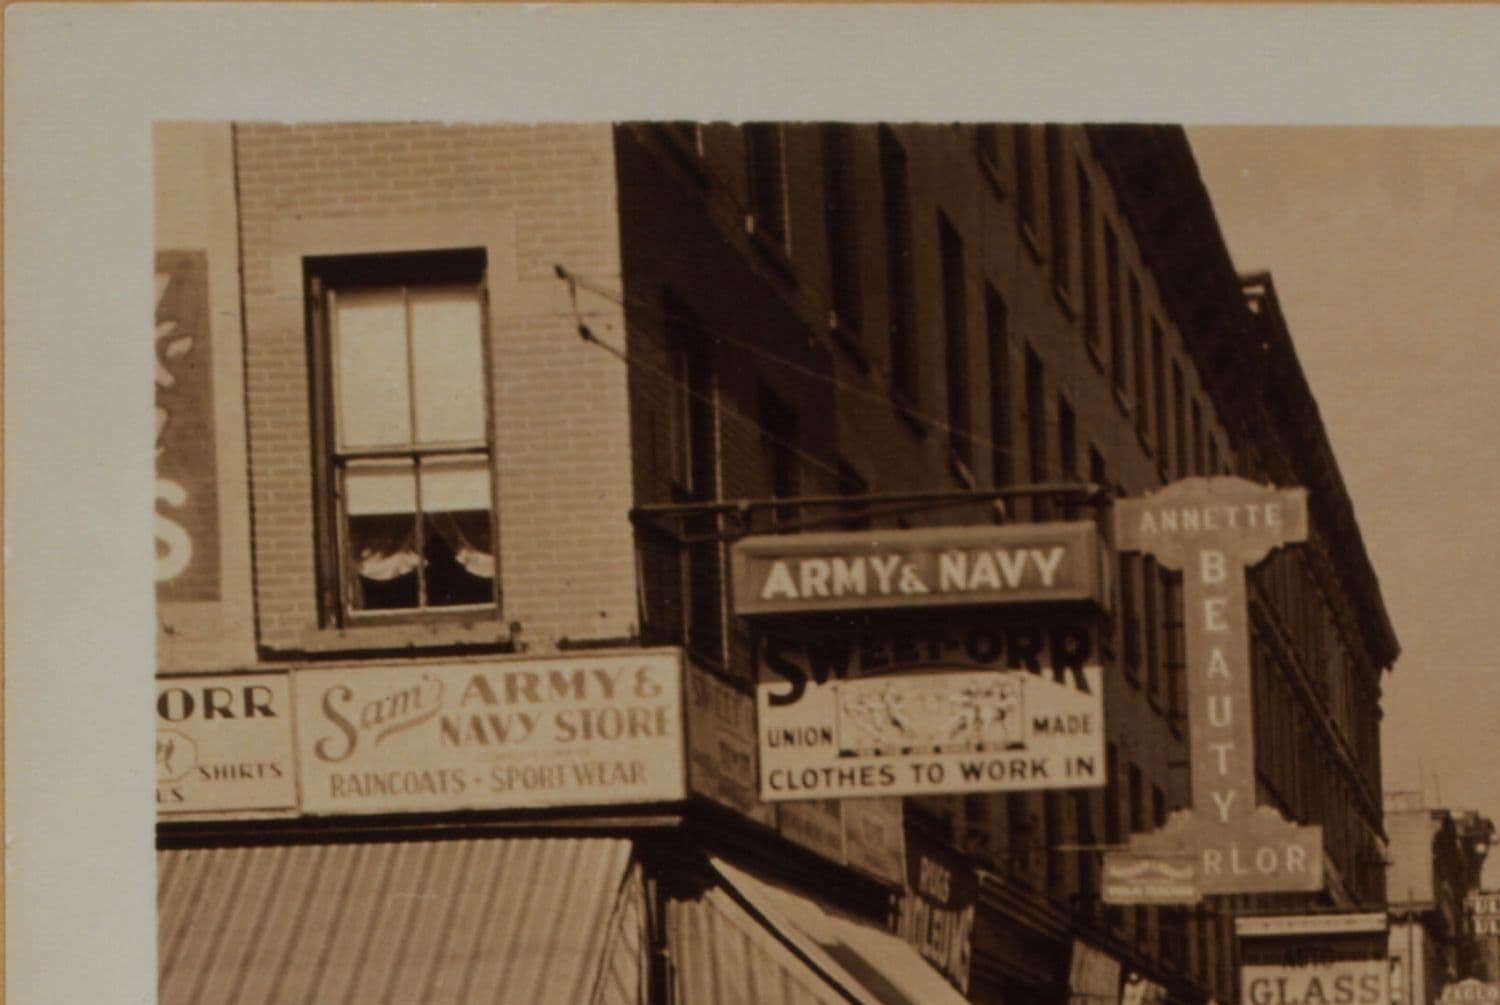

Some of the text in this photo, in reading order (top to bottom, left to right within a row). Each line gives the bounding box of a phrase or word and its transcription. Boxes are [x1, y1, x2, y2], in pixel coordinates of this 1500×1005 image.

[1140, 502, 1283, 535] ANNETTE
[761, 546, 1065, 599] ARMY & NAVY
[156, 684, 278, 723] ORR
[460, 668, 624, 707] ARMY
[633, 666, 663, 698] &
[1199, 547, 1238, 824] BEAUTY
[440, 704, 672, 747] NAVY STORE
[767, 713, 1093, 749] UNION MADE
[197, 761, 284, 781] SHIRTS
[330, 760, 647, 799] RAINCOATS SPORT WEAR
[769, 755, 1095, 791] CLOTHES TO WORK IN
